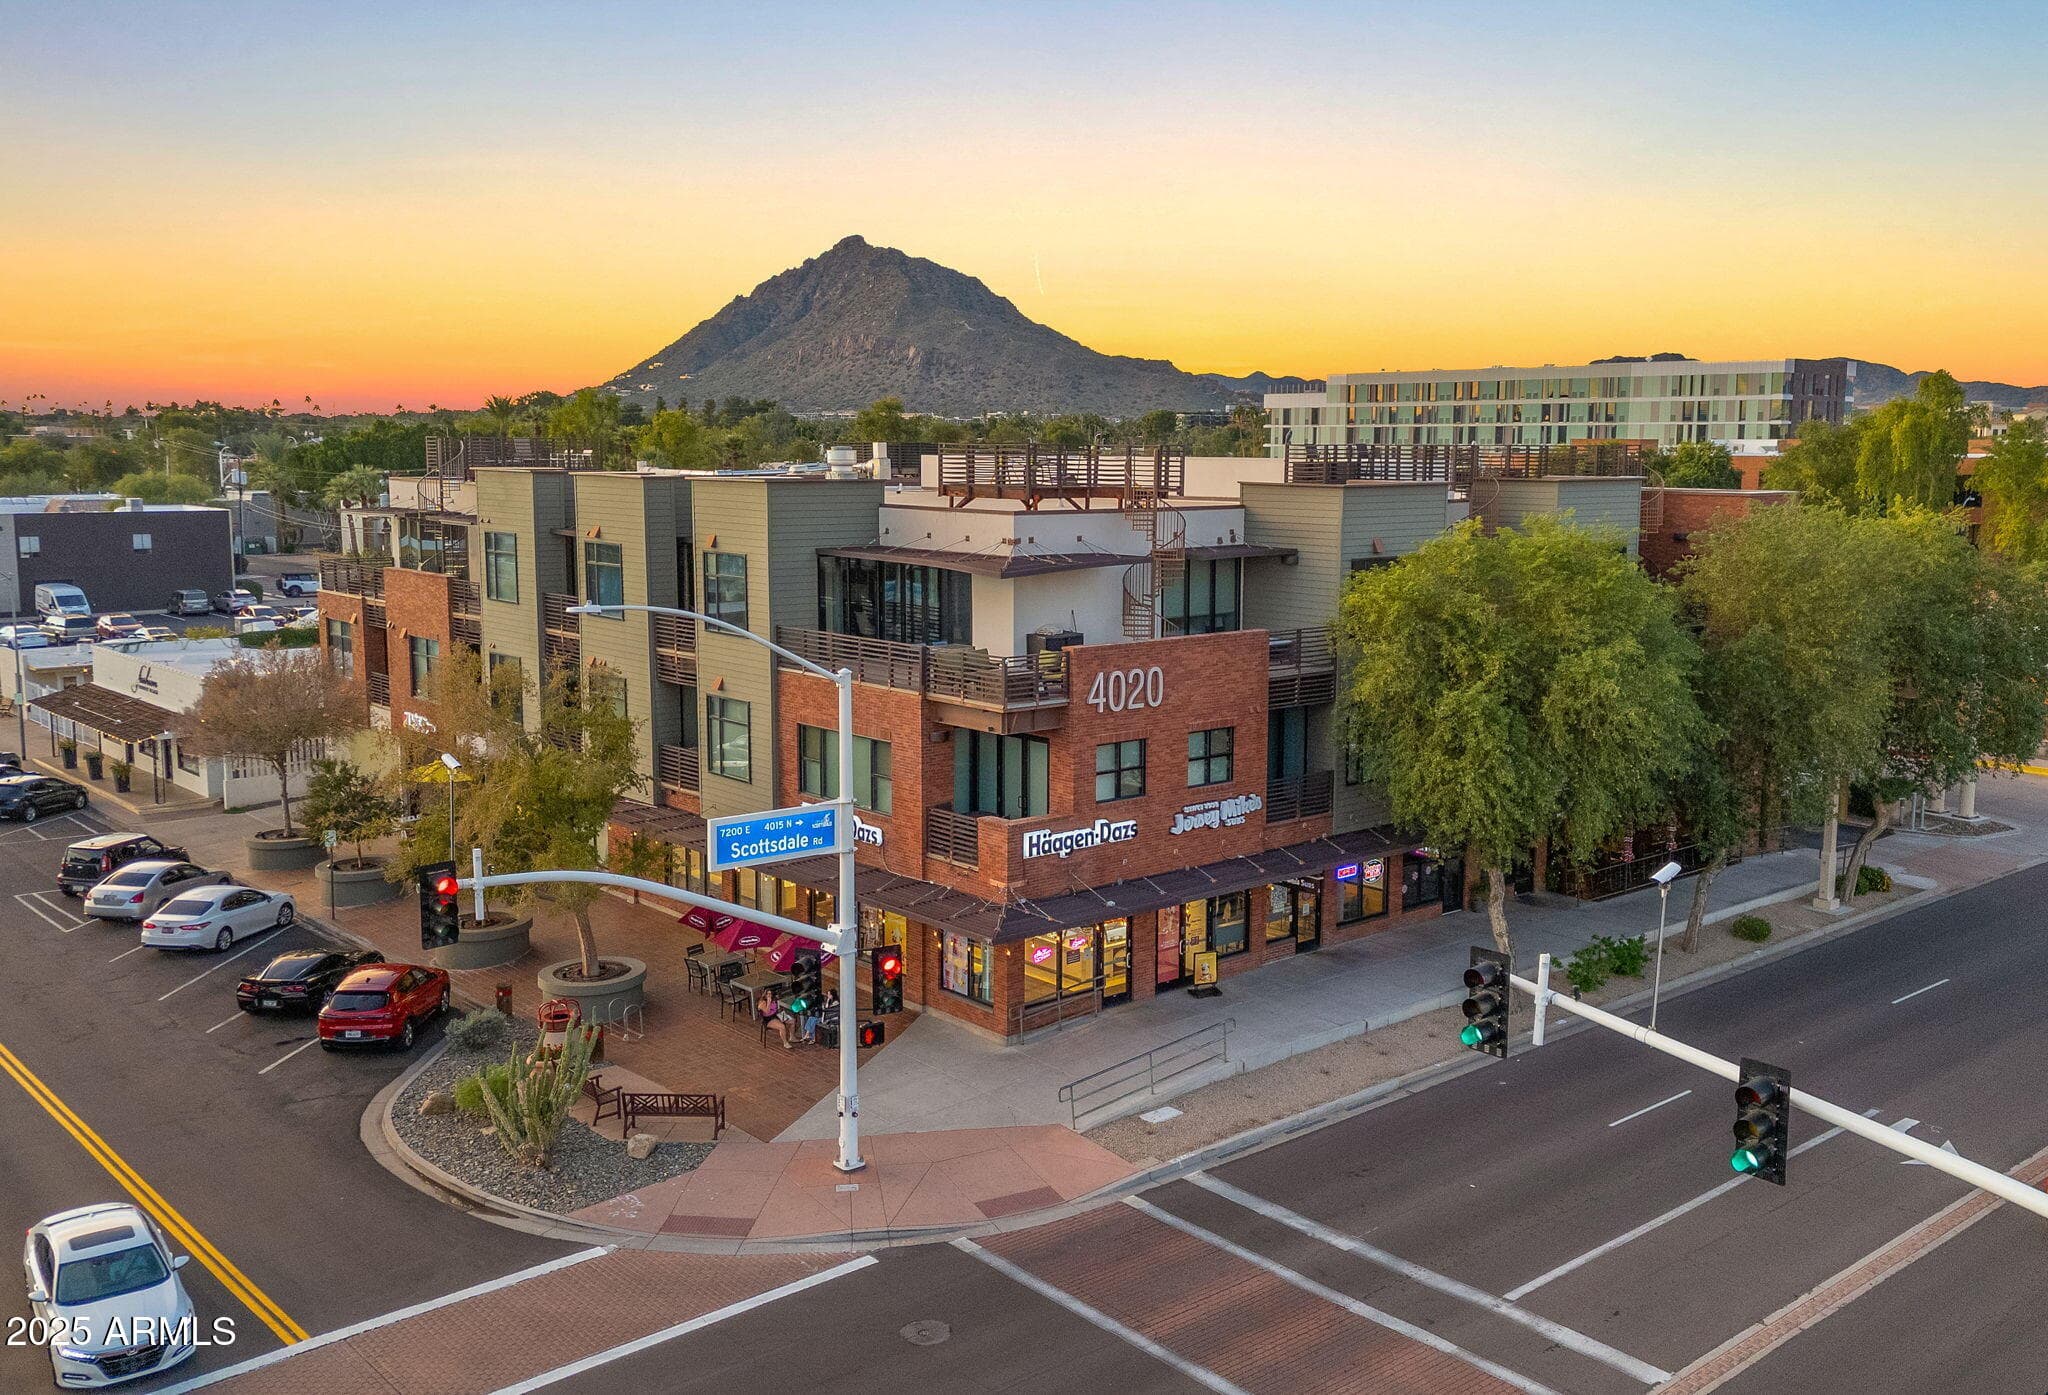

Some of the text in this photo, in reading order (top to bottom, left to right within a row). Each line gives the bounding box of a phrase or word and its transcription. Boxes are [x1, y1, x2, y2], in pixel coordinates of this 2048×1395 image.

[1086, 666, 1164, 713] 4020
[720, 819, 792, 838] 7200 E 4015 N
[853, 820, 878, 845] azs
[730, 833, 823, 859] Scottsdale Rd
